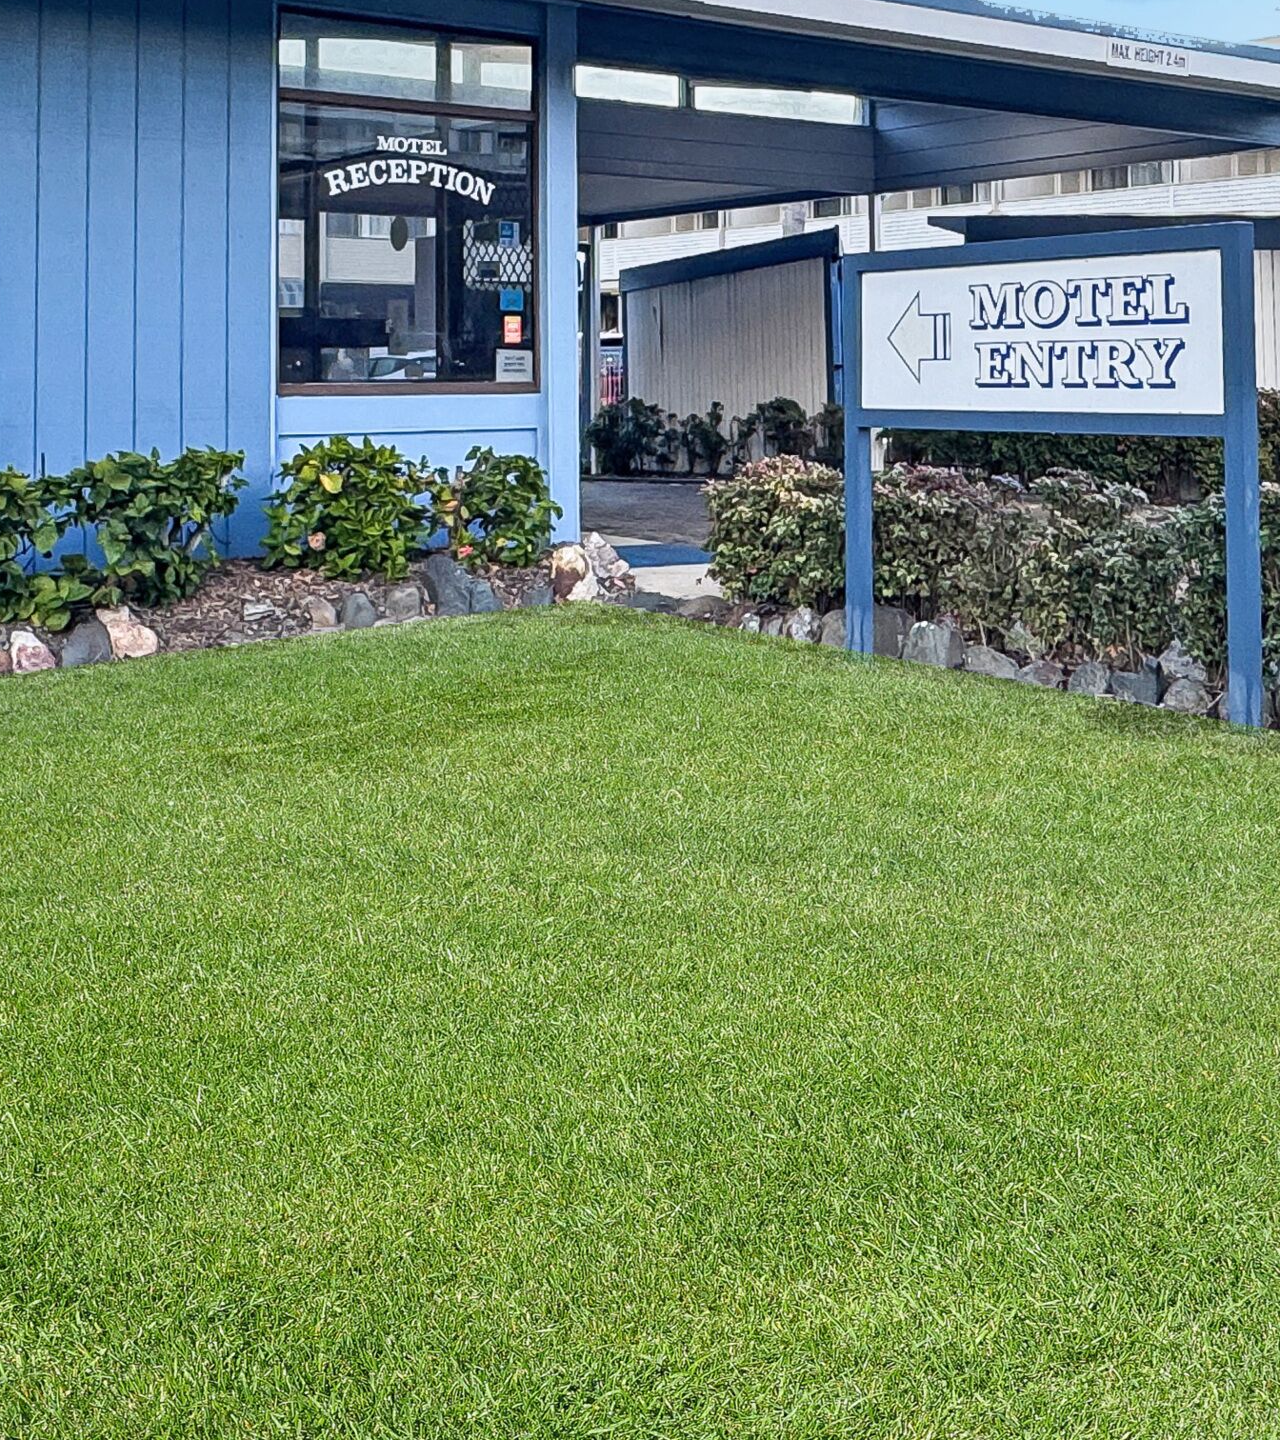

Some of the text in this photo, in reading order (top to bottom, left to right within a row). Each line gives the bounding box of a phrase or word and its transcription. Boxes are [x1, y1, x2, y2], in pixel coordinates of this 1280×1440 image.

[376, 135, 447, 155] MOTEL
[324, 159, 496, 205] RECEPTION
[968, 274, 1190, 329] MOTEL
[974, 338, 1186, 389] ENTRY
